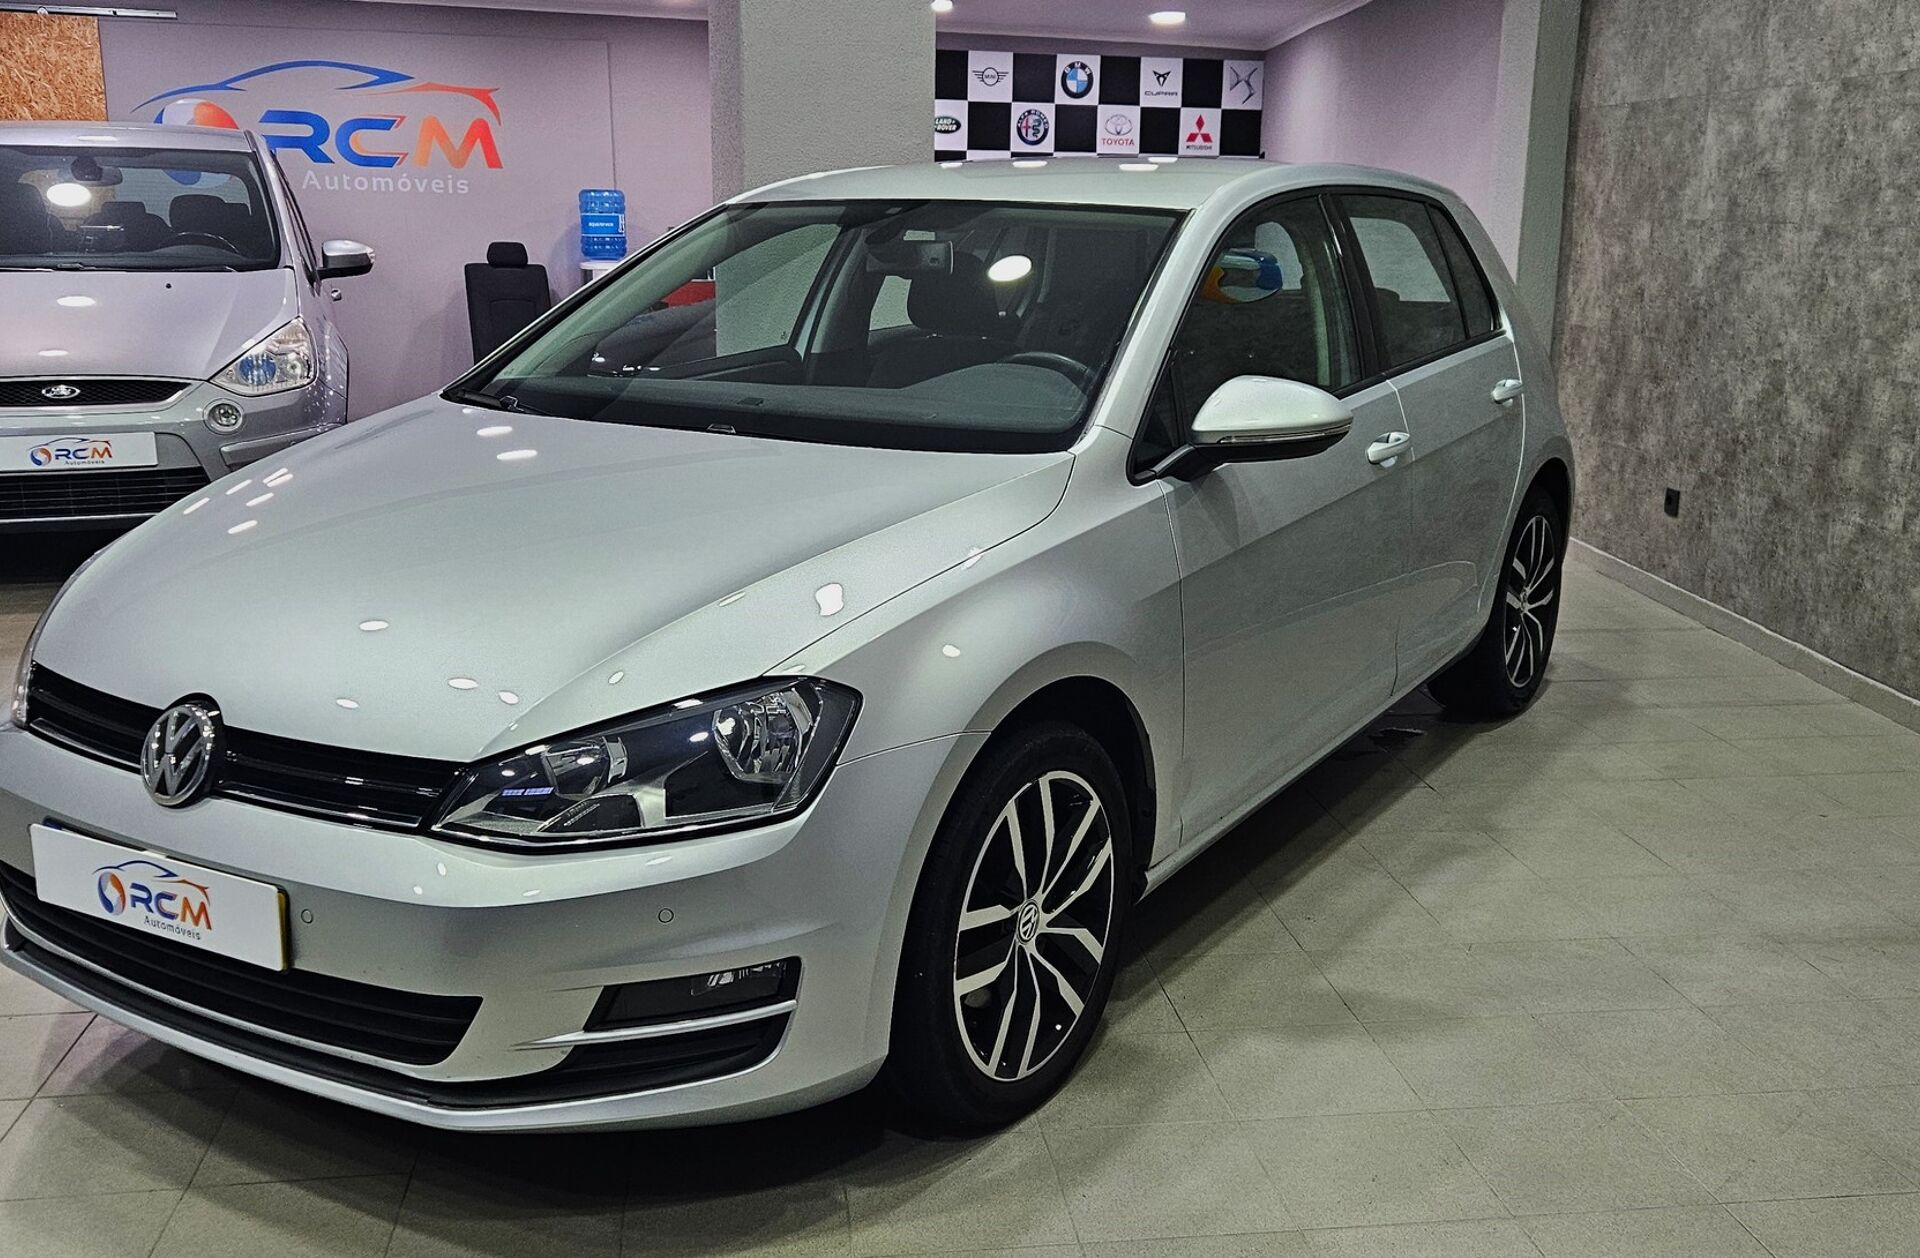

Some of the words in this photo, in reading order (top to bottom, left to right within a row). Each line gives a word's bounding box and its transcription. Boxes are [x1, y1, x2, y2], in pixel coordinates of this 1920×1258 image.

[1064, 61, 1092, 75] BMW
[258, 109, 503, 169] RCM
[1102, 137, 1135, 147] TOYOTA
[302, 169, 470, 195] Automóveis
[54, 446, 113, 461] RCM
[130, 882, 213, 931] RCM
[143, 914, 202, 941] Automóveis
